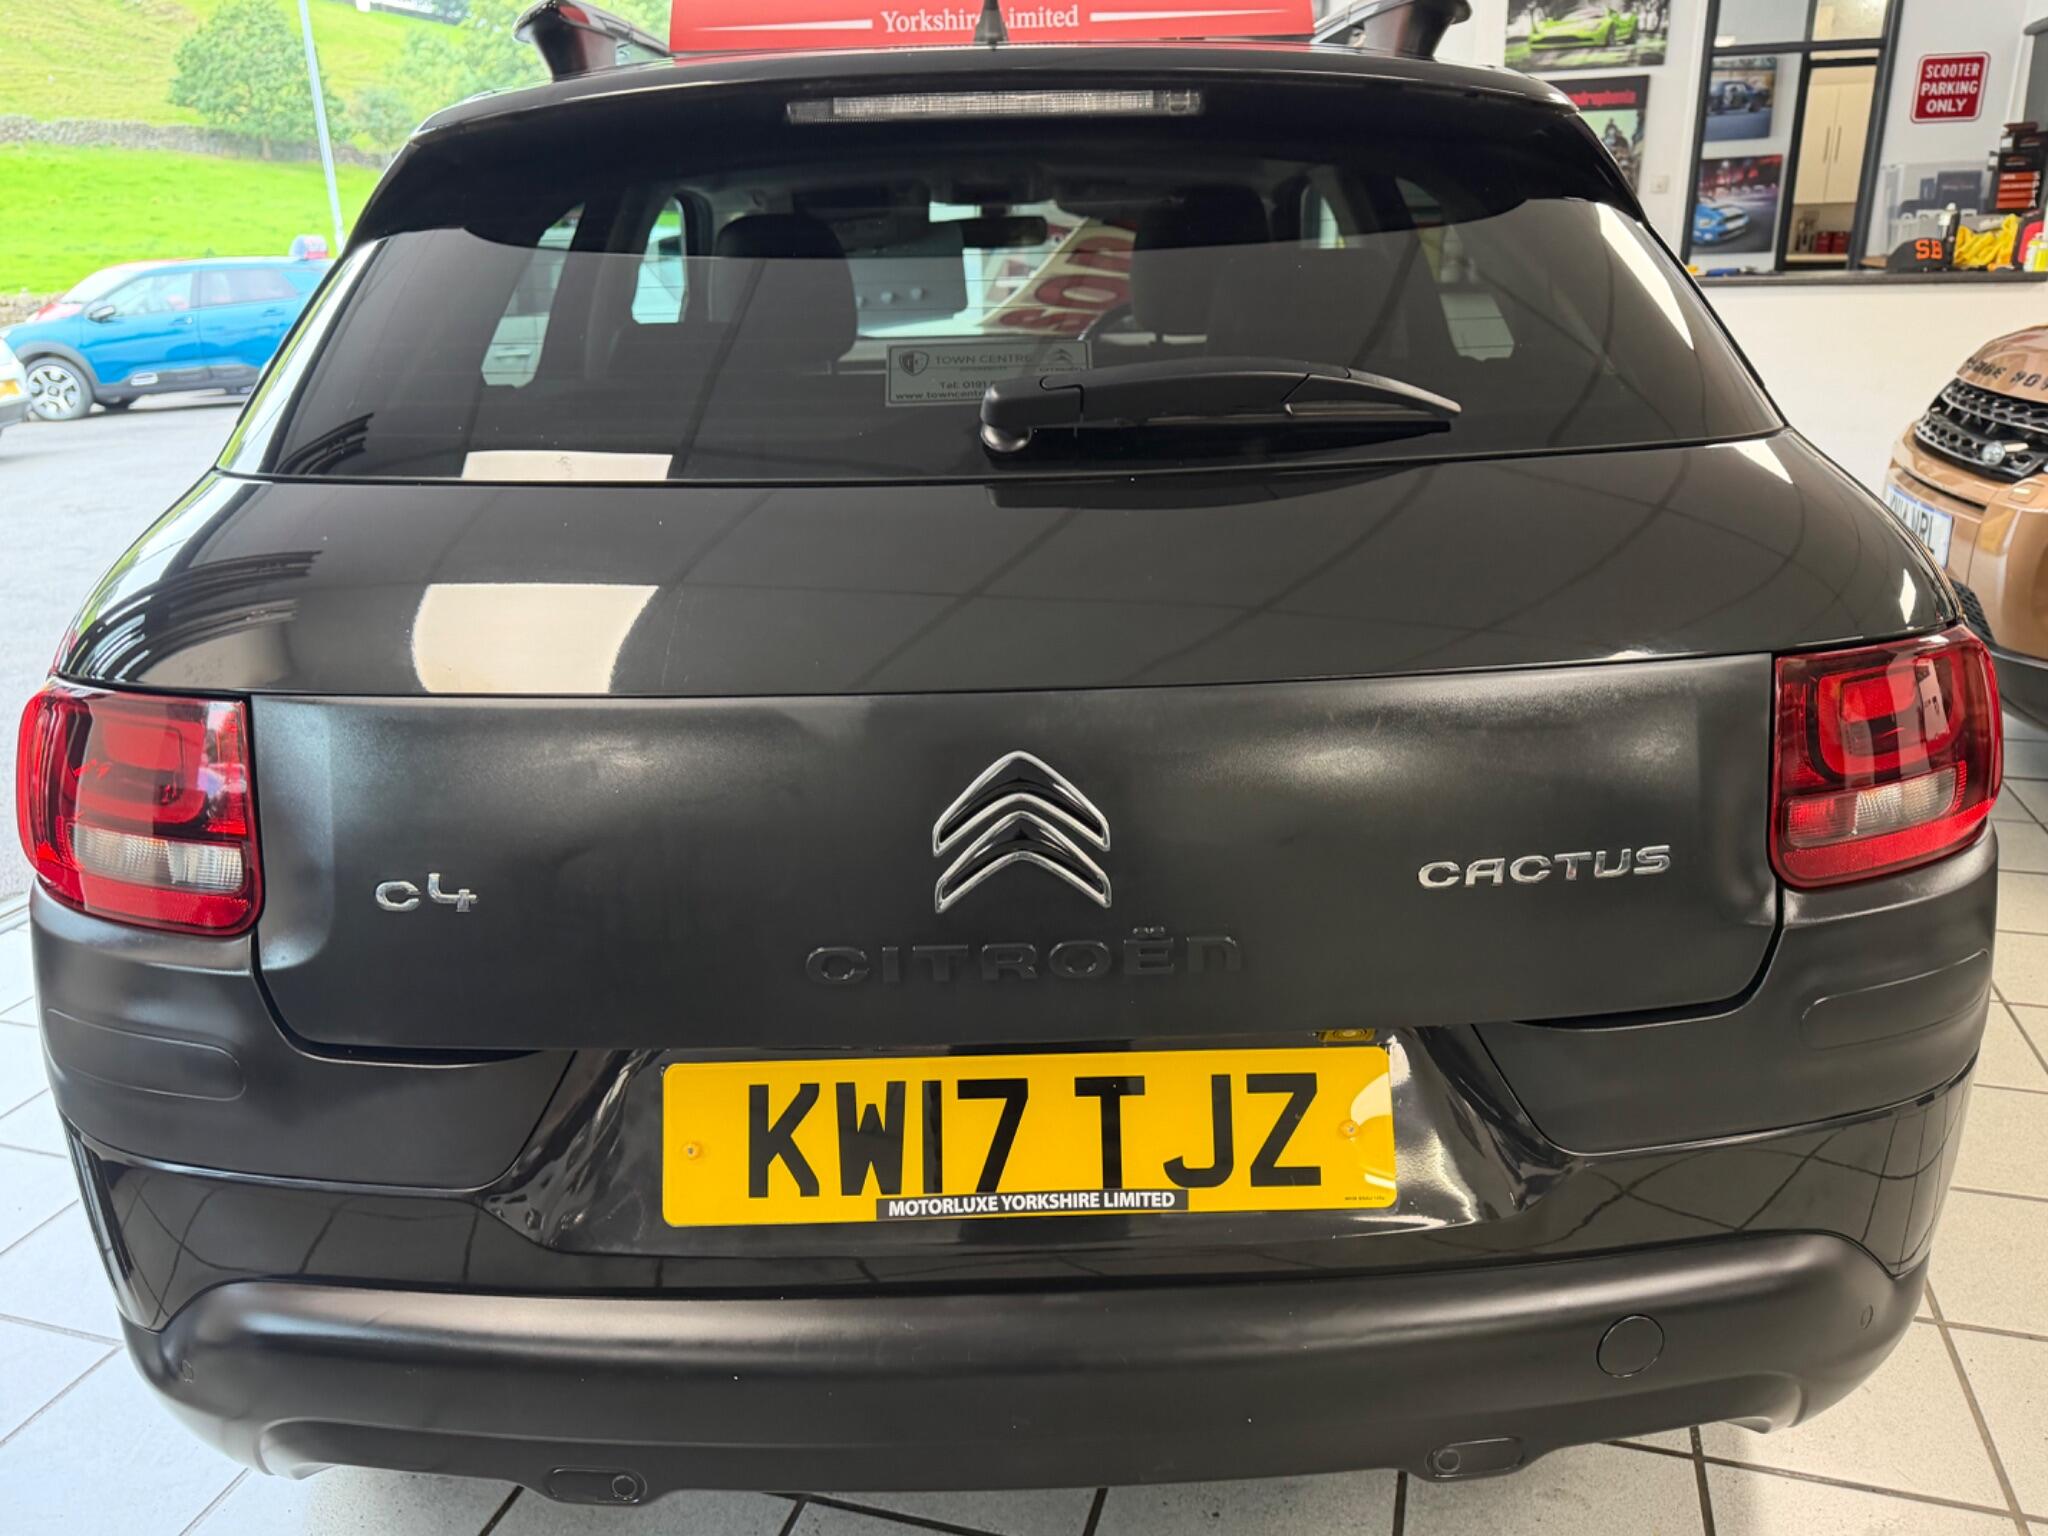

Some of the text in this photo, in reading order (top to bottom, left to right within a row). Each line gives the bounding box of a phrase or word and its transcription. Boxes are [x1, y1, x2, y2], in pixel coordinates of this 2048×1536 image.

[881, 5, 1079, 32] Yorkshir imited
[1925, 63, 1980, 79] SCOOTER
[1920, 80, 1979, 96] PARKING
[1925, 98, 1968, 113] ONLY
[936, 354, 975, 365] TOWN
[1417, 844, 1671, 889] CACTUS
[375, 872, 478, 913] C4
[748, 1072, 1321, 1198] KW17 TJZ
[888, 1191, 1176, 1217] MOTORLUXE YORKSHIRE LIMITED
